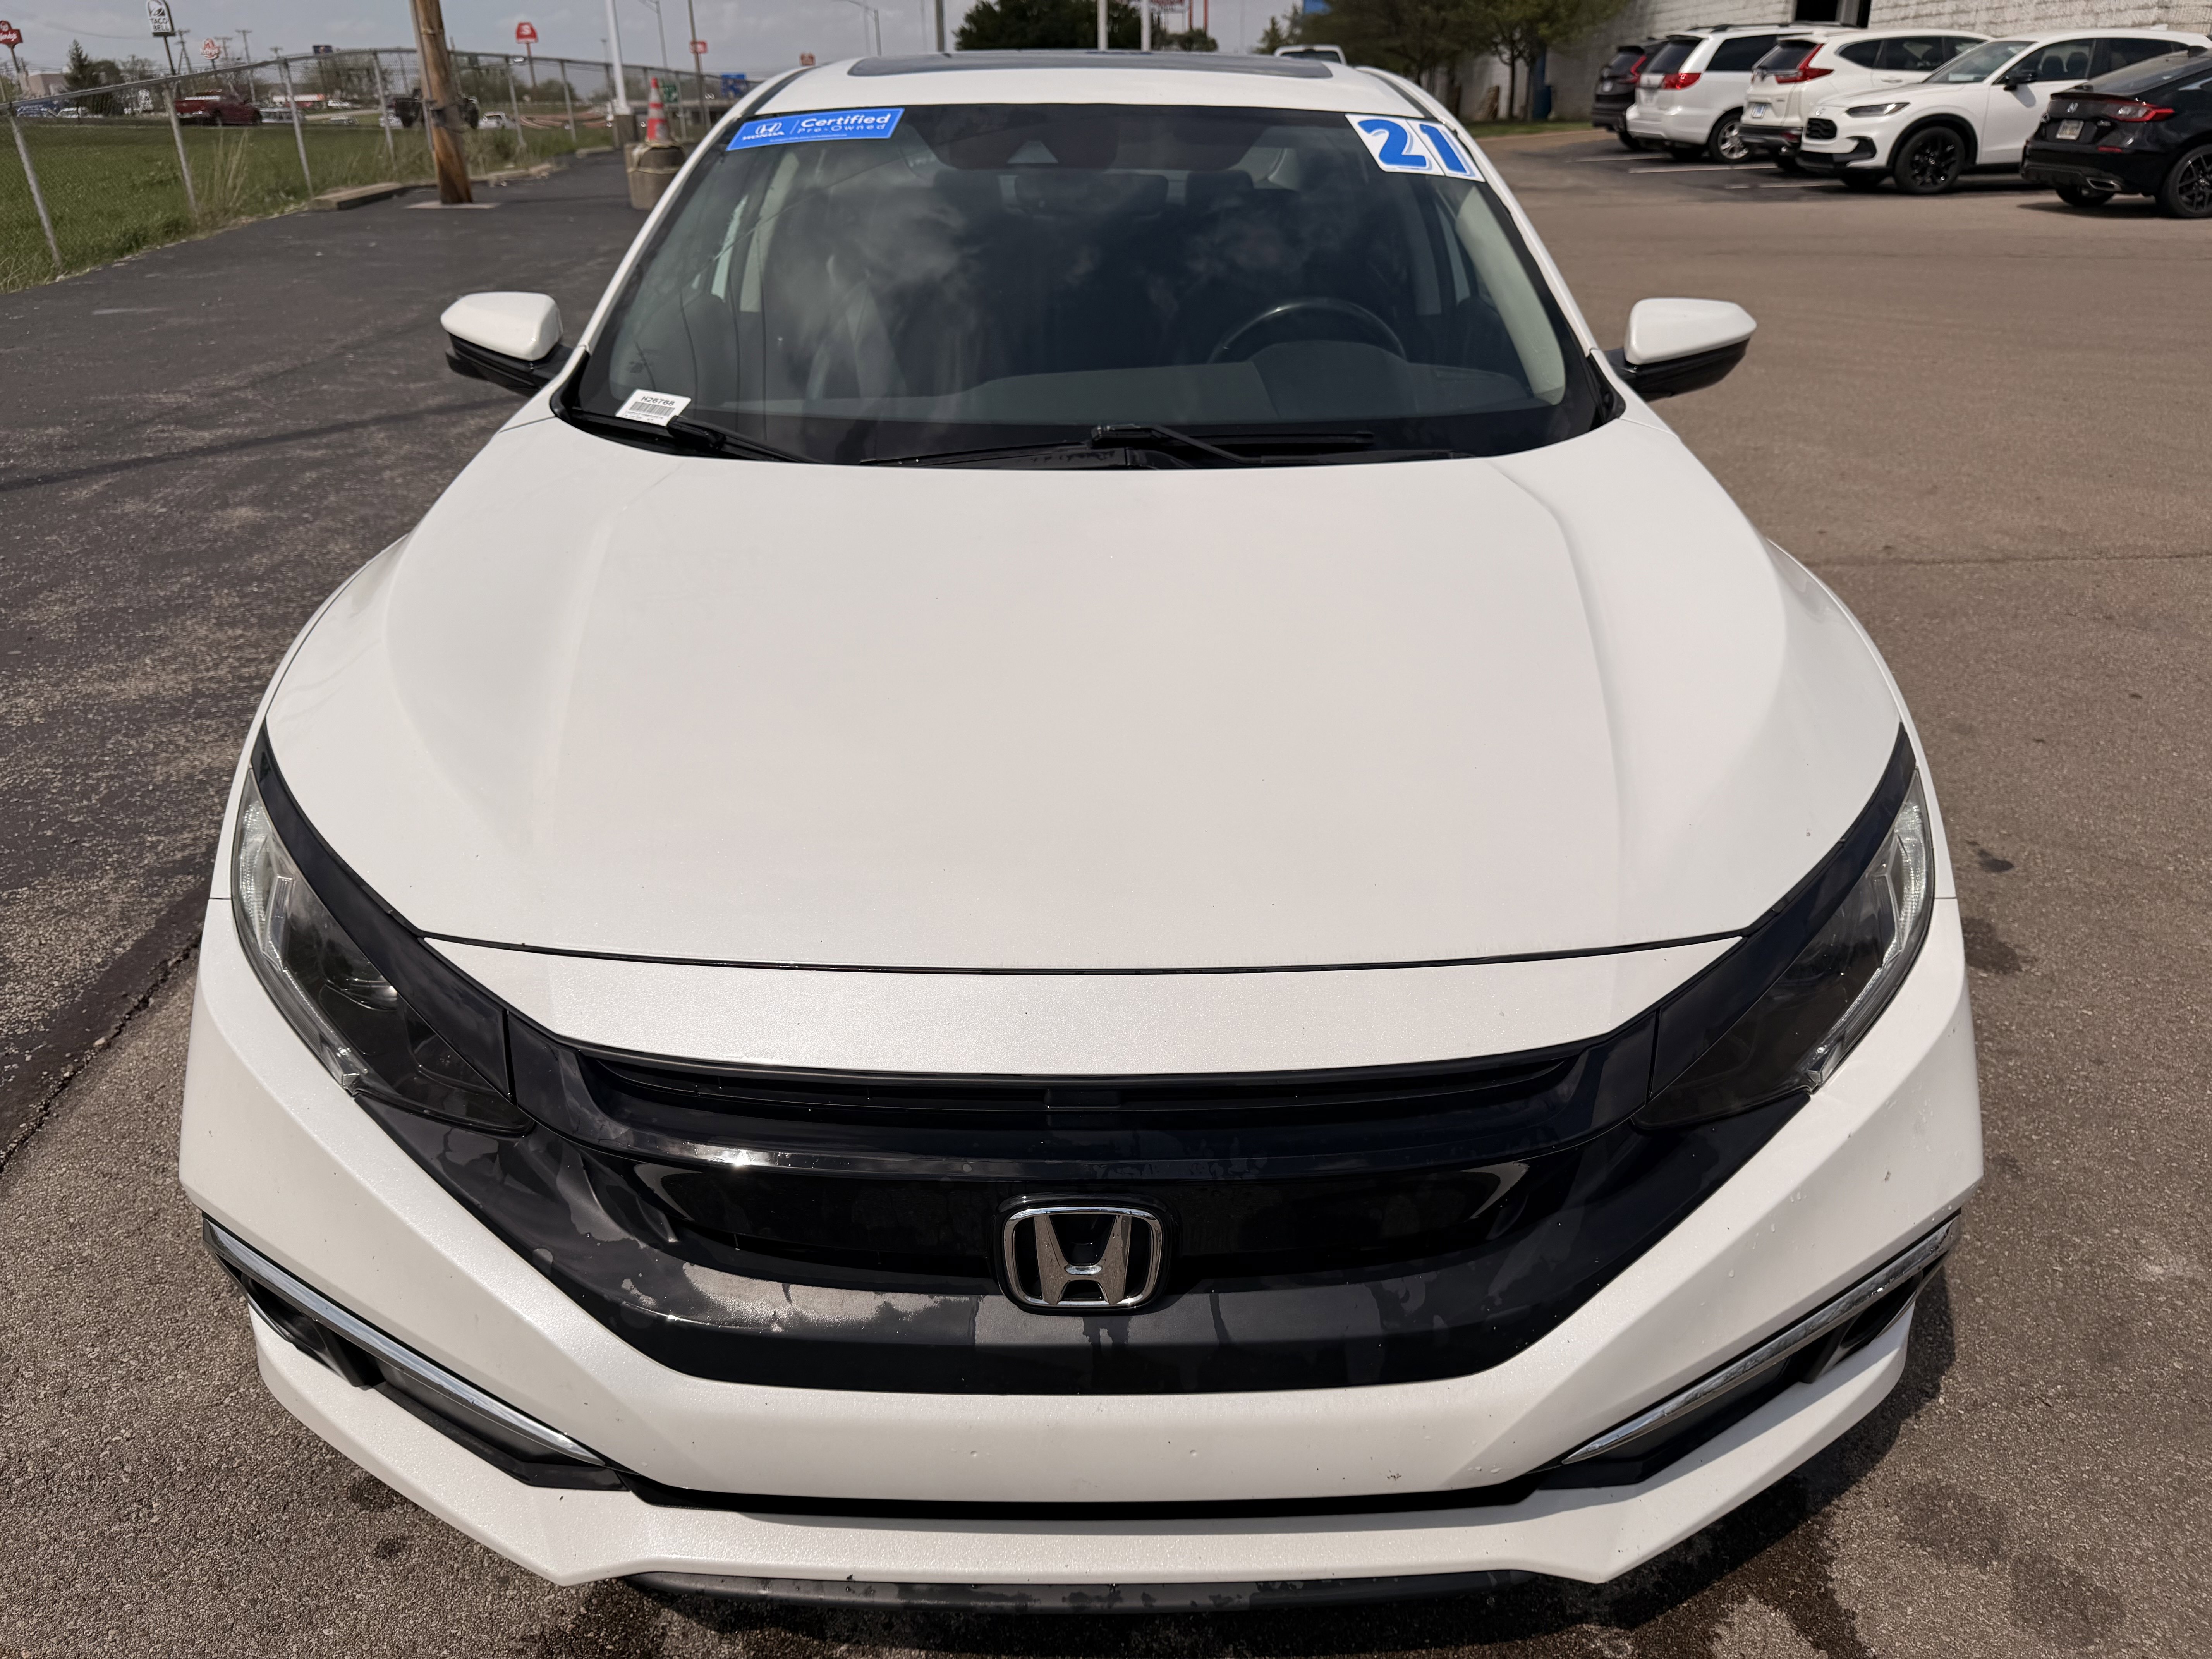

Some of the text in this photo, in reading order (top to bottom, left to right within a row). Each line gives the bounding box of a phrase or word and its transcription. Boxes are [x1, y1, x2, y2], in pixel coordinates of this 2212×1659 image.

[800, 113, 891, 128] Certified
[797, 124, 886, 134] Pre-Owned
[1358, 119, 1470, 175] 21
[641, 396, 675, 406] H26768
